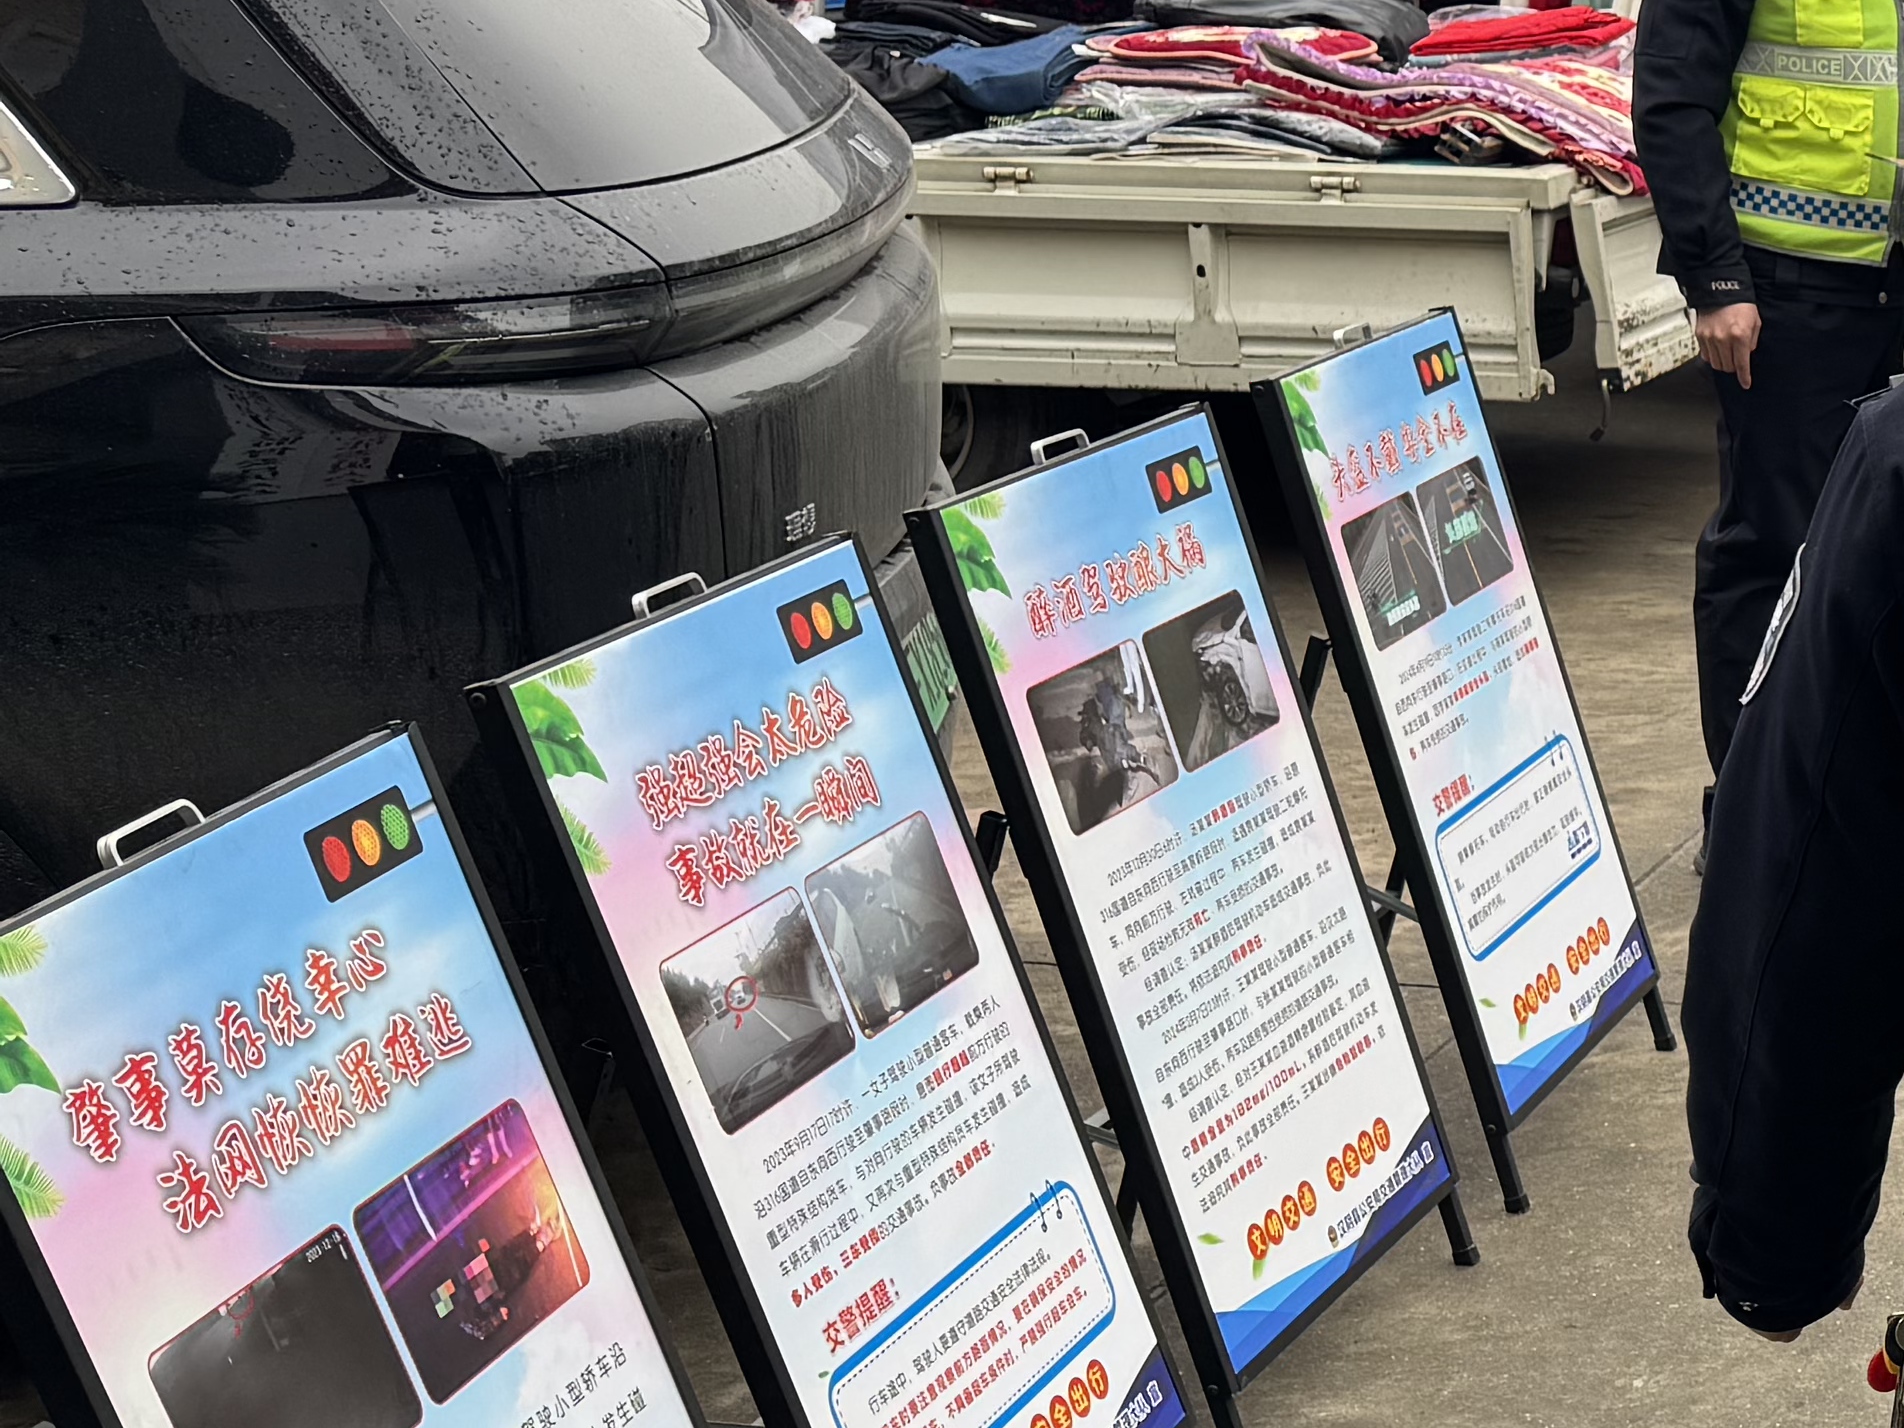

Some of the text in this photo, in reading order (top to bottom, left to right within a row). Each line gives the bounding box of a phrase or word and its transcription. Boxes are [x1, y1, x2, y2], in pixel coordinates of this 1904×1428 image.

[1777, 56, 1842, 76] POLICE
[636, 677, 853, 830] 强超强会太危险
[667, 756, 882, 907] 事故就在一瞬间
[63, 929, 387, 1163] 肇事莫存侥幸心
[157, 993, 472, 1233] 法网恢恢罪难逃
[1249, 1121, 1389, 1257] 文明交通 安全出行
